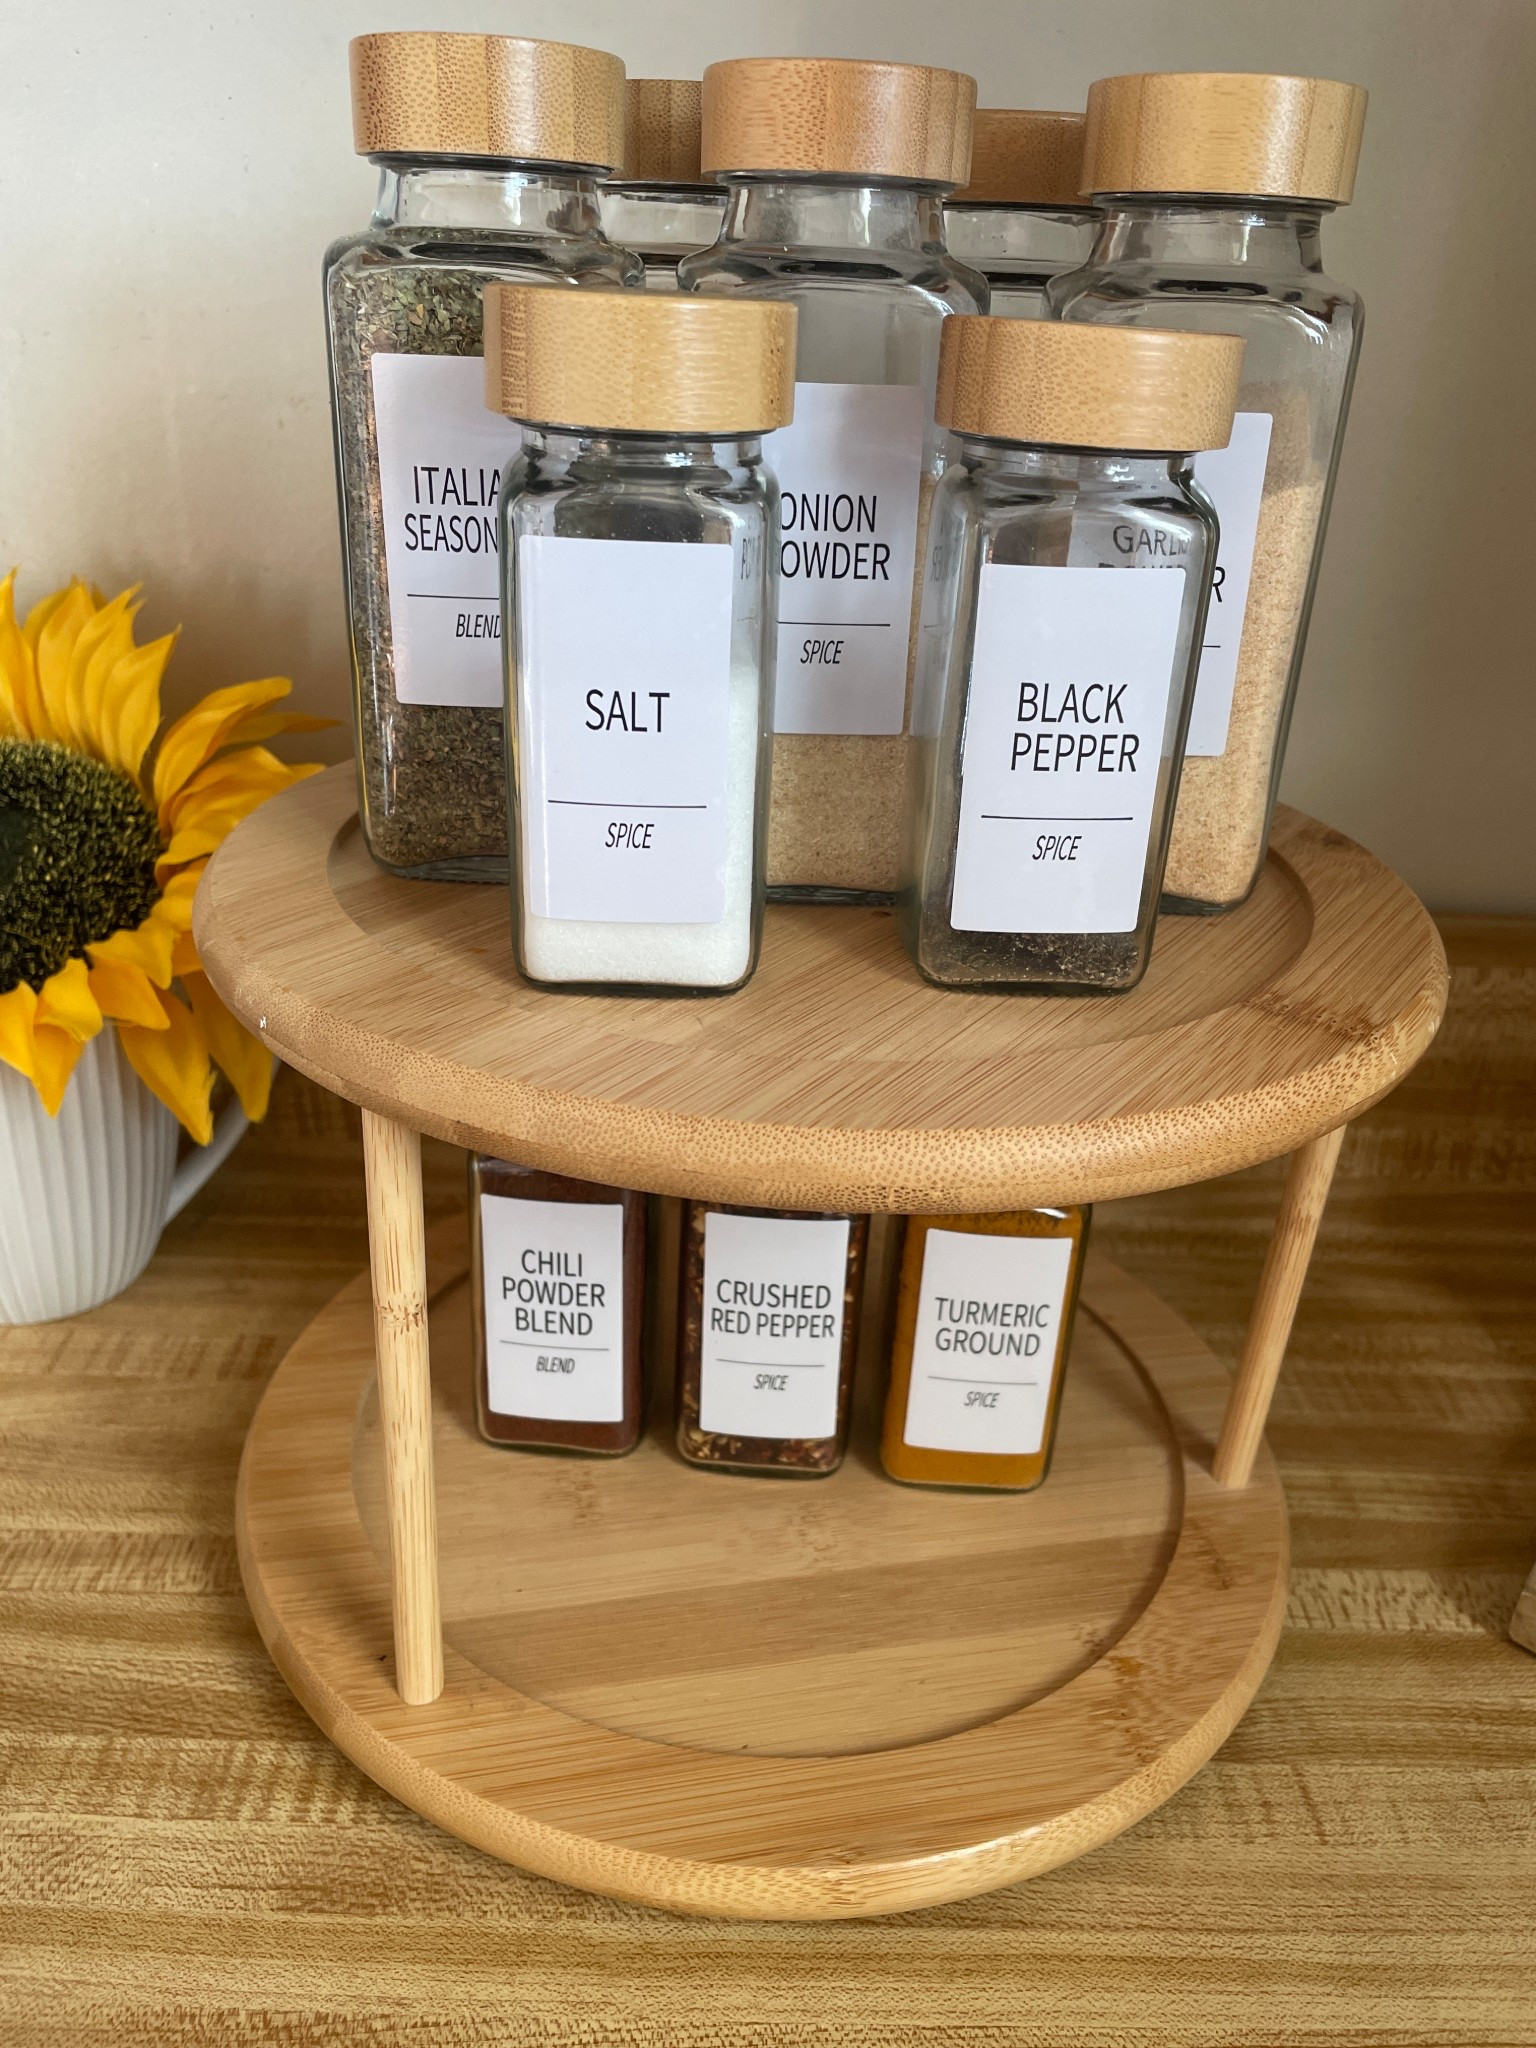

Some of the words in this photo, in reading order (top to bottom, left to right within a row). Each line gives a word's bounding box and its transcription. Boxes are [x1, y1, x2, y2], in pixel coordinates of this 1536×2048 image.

[413, 465, 501, 507] ITALIA
[780, 491, 878, 533] ONION
[404, 513, 499, 554] SEASON
[780, 540, 891, 581] OWDER
[455, 613, 502, 639] BLEND
[799, 639, 845, 665] SPICE
[585, 688, 671, 733] SALT
[1017, 682, 1128, 724] BLACK
[1010, 733, 1140, 773] PEPPER
[604, 822, 655, 849] SPICE
[1031, 834, 1083, 861] SPICE
[521, 1248, 584, 1278] CHILI
[501, 1276, 606, 1309] POWDER
[716, 1278, 832, 1309] CRUSHED
[514, 1306, 594, 1336] BLEND
[711, 1308, 752, 1334] RED
[756, 1311, 836, 1339] PEPPER
[934, 1296, 1050, 1329] TURMERIC
[935, 1326, 1042, 1358] GROUND
[536, 1356, 576, 1375] BLEND
[753, 1373, 789, 1391] SPICE
[963, 1390, 1000, 1409] SPICE
